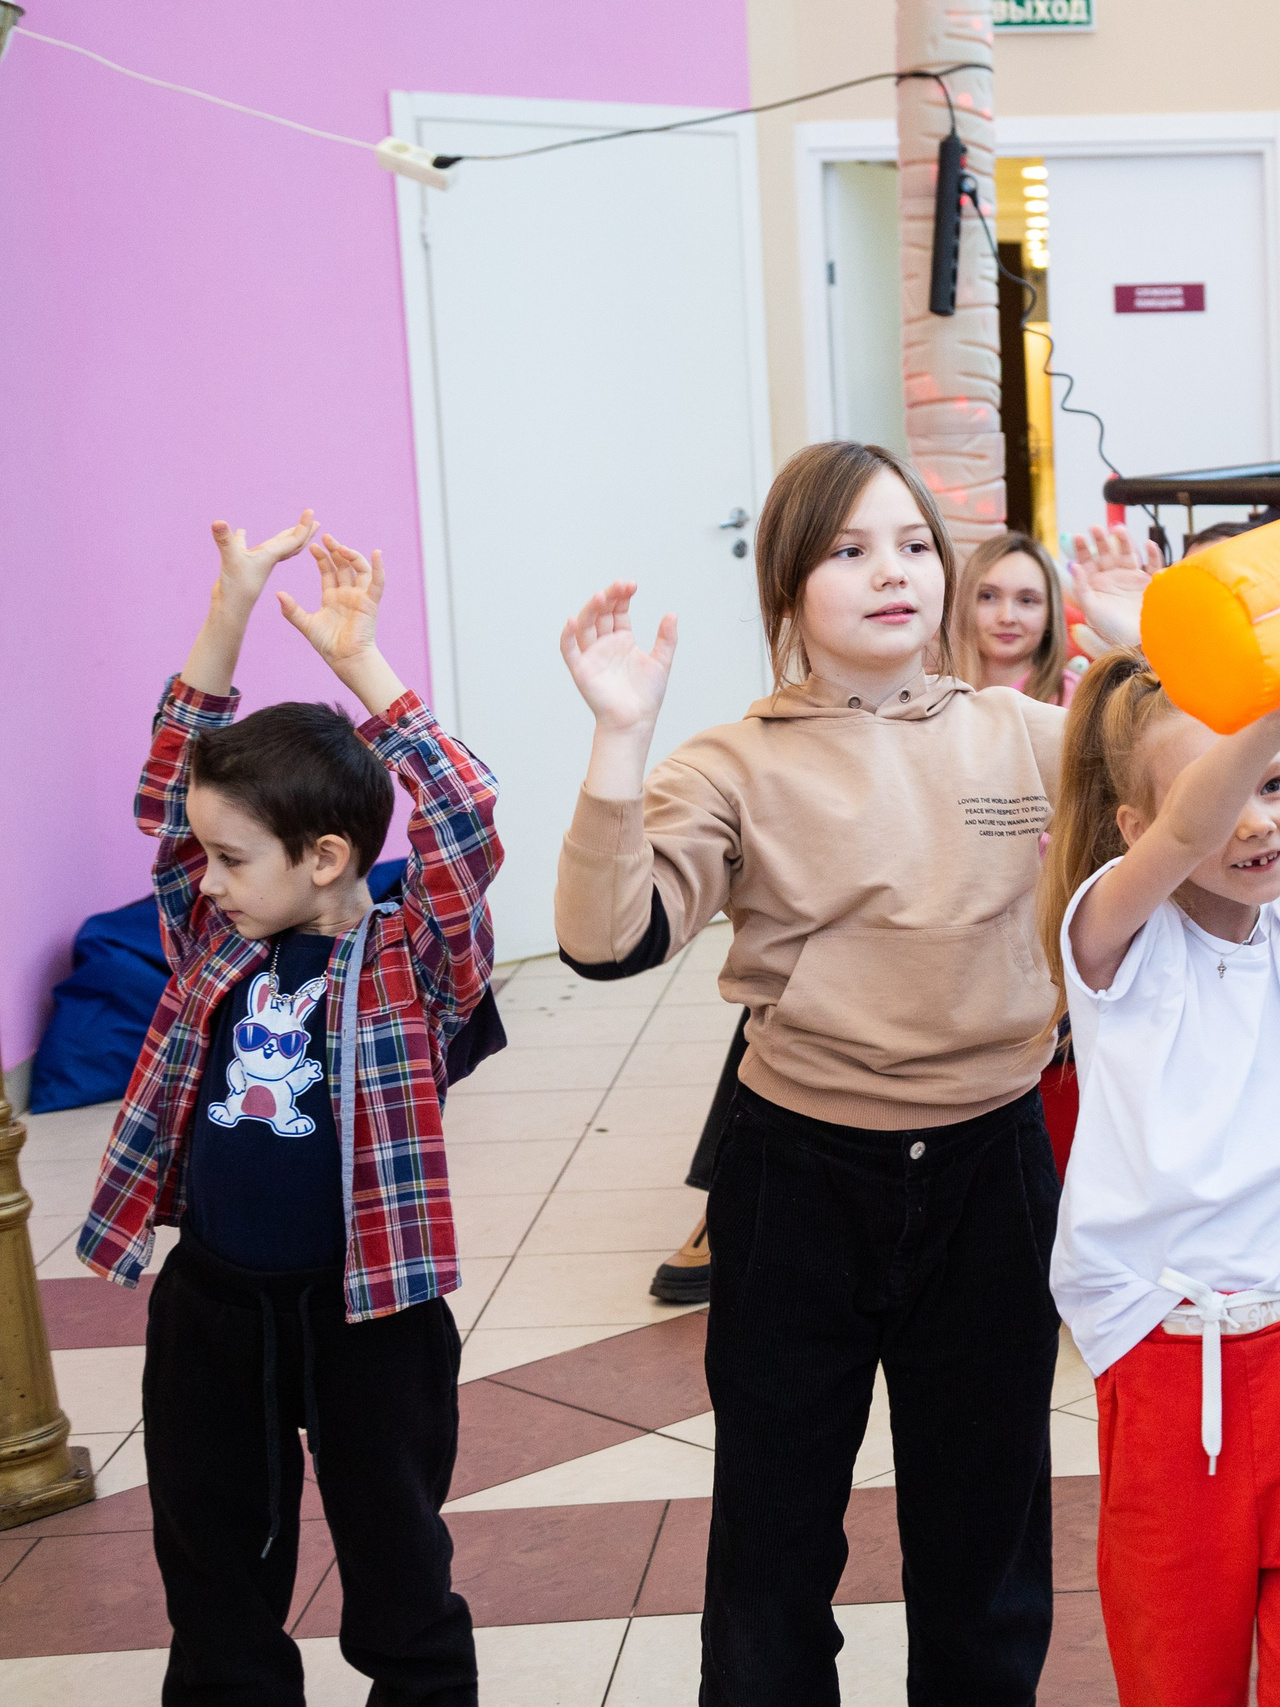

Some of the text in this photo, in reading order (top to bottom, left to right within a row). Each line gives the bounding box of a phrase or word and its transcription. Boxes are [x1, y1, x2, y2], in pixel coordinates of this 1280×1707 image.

[958, 797, 980, 805] LOVING
[997, 808, 1020, 816] RESPECT
[1007, 818, 1029, 826] WANNA
